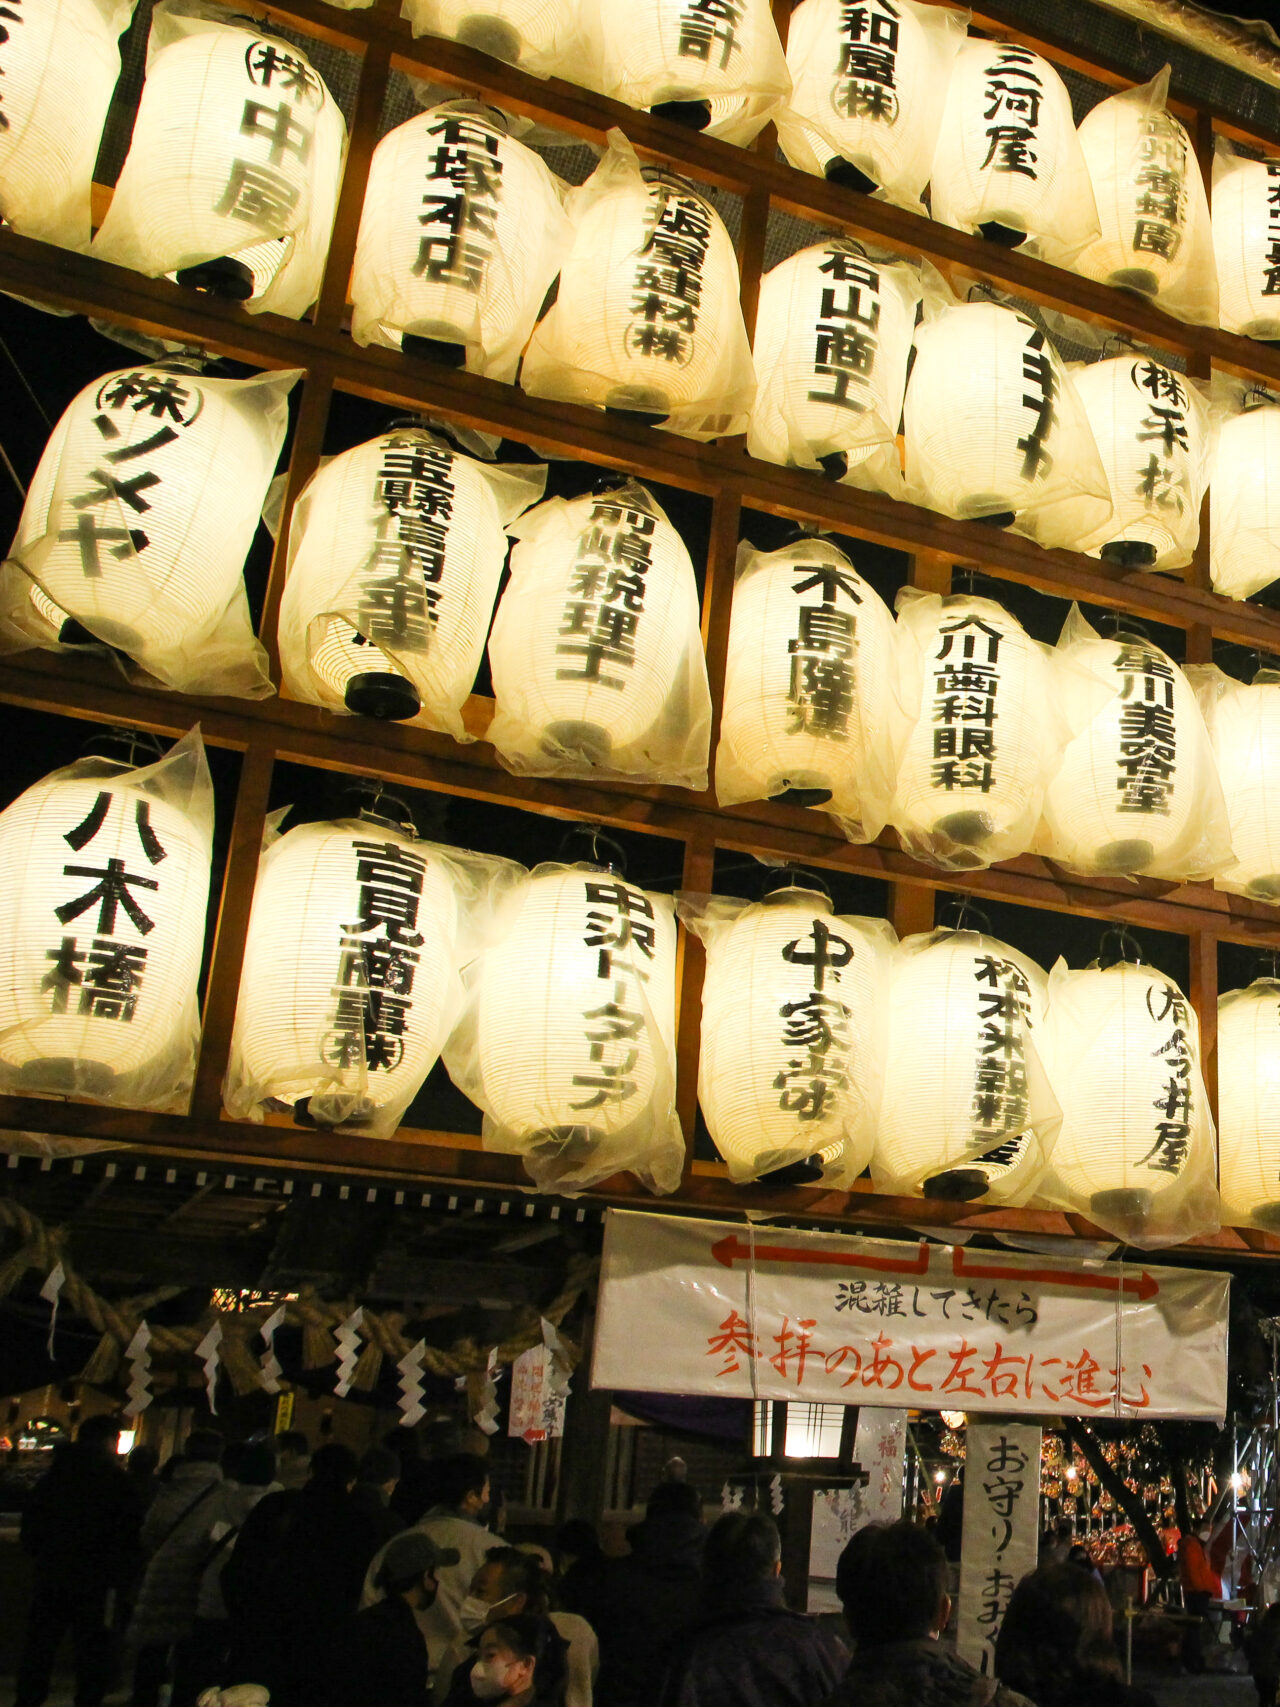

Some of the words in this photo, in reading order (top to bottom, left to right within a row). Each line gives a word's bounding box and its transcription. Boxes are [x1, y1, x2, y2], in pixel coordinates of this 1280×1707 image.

[980, 44, 1043, 180] 三河屋
[411, 113, 508, 294] 石塚本店
[807, 250, 881, 413] 石山商工
[40, 791, 167, 1023] 八木橋
[706, 1310, 1152, 1409] 参拝のあと左右に進む
[835, 1281, 1038, 1326] 混雑してきたら
